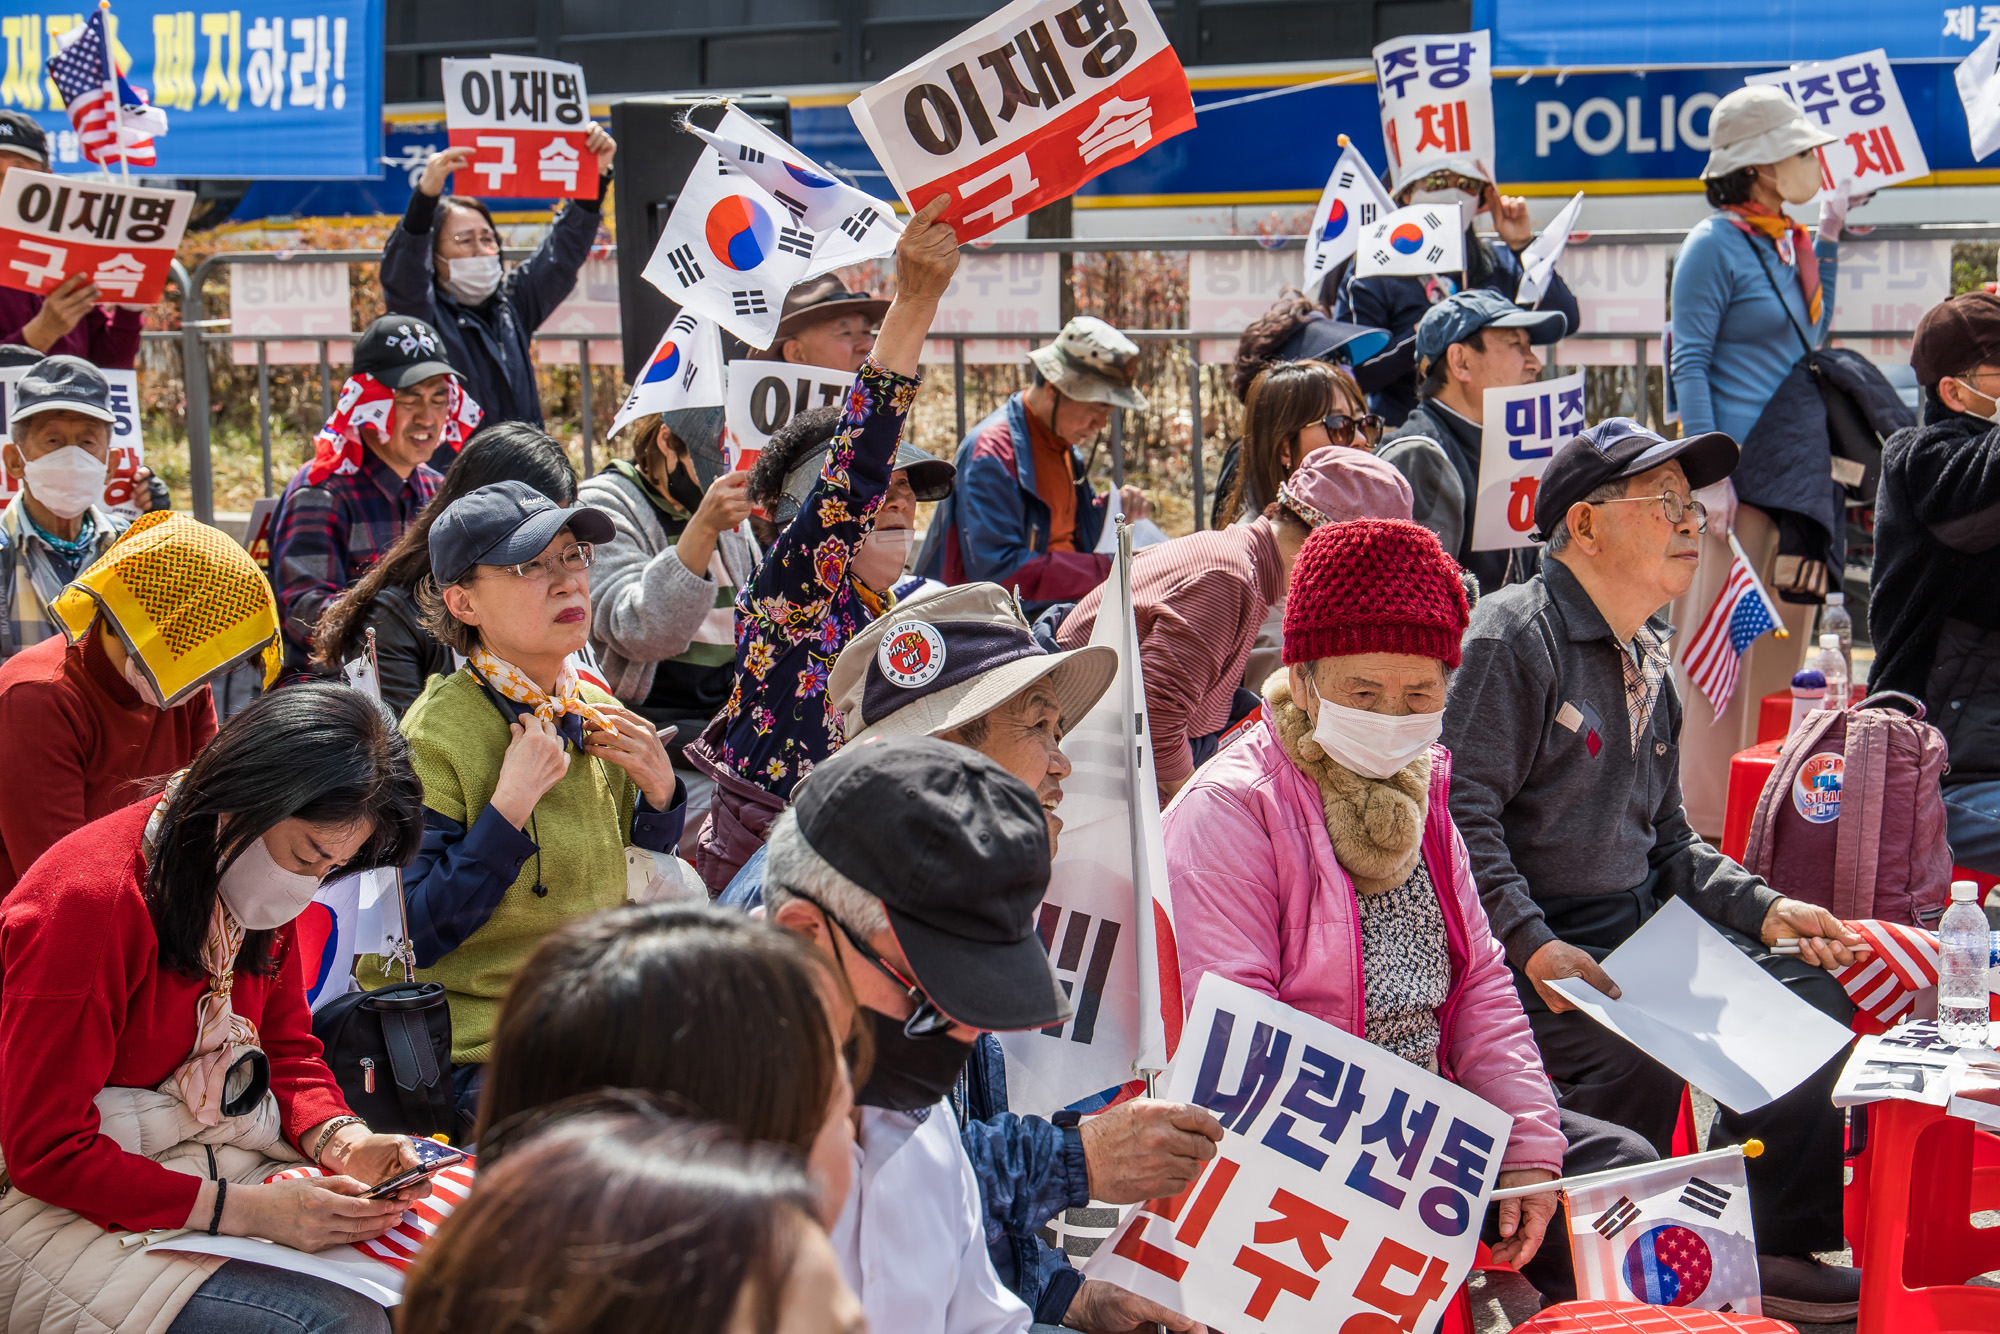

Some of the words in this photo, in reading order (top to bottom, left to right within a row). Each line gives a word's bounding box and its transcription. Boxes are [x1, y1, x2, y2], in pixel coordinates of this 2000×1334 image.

[461, 70, 583, 124] 이재명
[904, 0, 1138, 155] 이재명
[1375, 42, 1476, 112] 주당
[1775, 62, 1886, 125] 주당
[18, 183, 176, 242] 이재명
[898, 624, 915, 633] OUT
[902, 648, 921, 668] OUT
[1808, 758, 1843, 772] STOP
[1812, 775, 1837, 788] THE
[1192, 1007, 1497, 1237] 내란선동
[1112, 1156, 1450, 1334] 민주당
